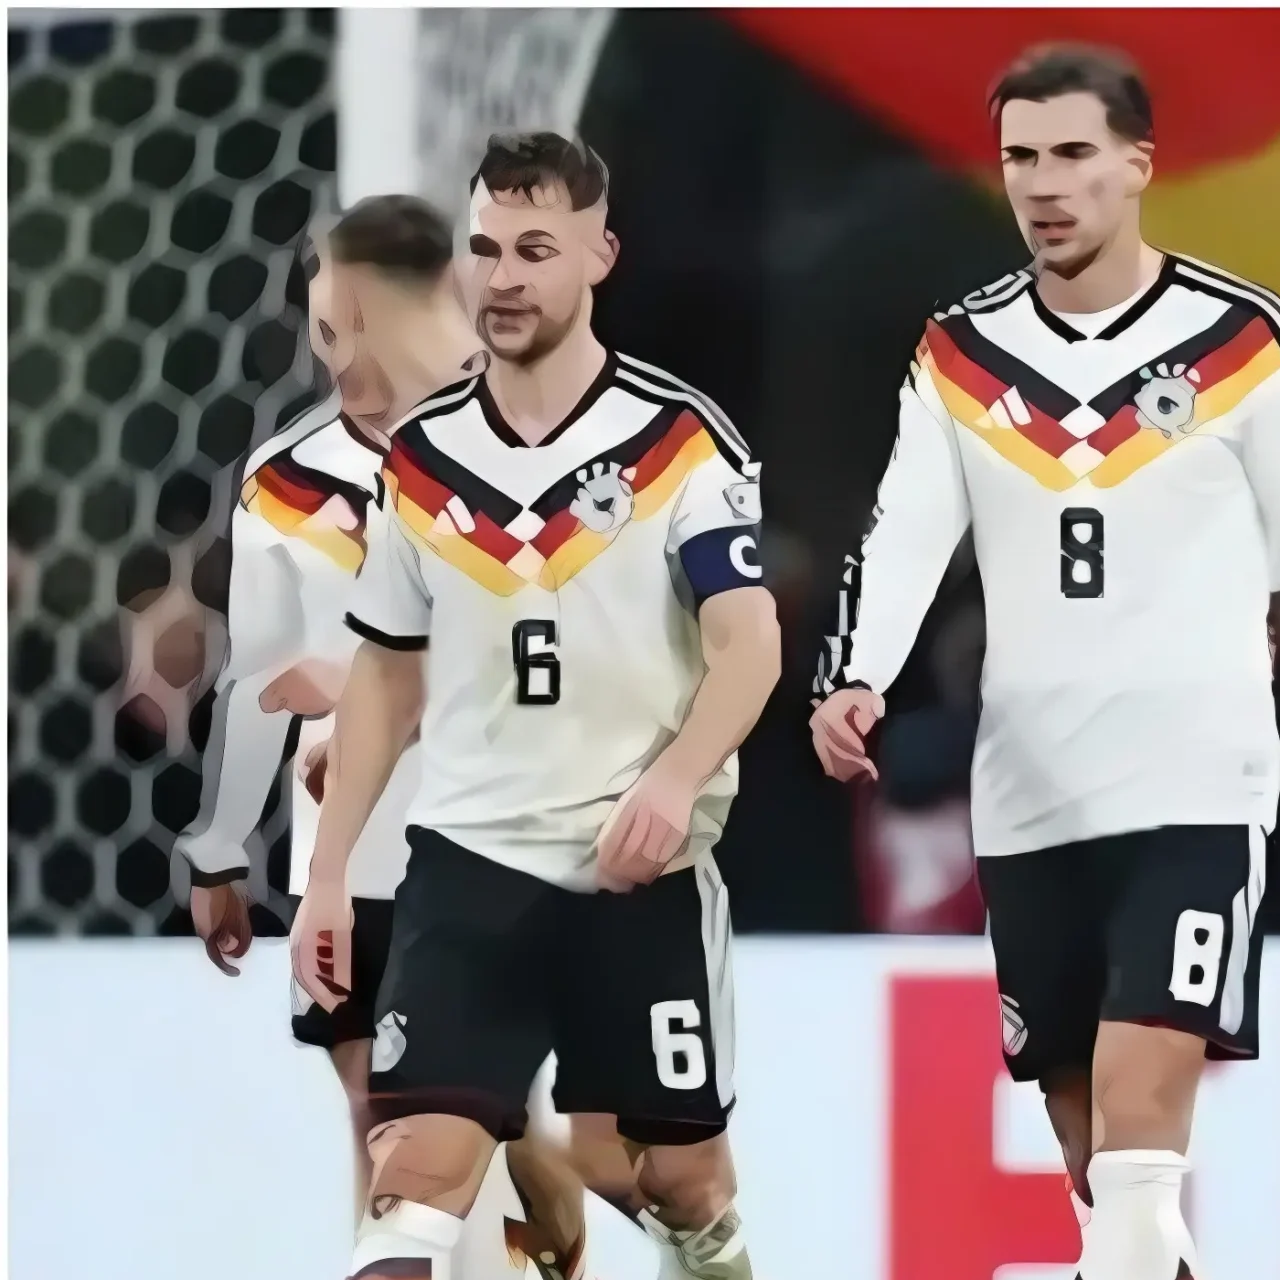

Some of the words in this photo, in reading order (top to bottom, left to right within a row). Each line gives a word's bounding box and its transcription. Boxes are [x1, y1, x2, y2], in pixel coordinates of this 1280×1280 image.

[1060, 507, 1105, 599] 8
[511, 618, 562, 706] 6
[1169, 909, 1226, 1006] 8
[649, 1000, 707, 1090] 6
